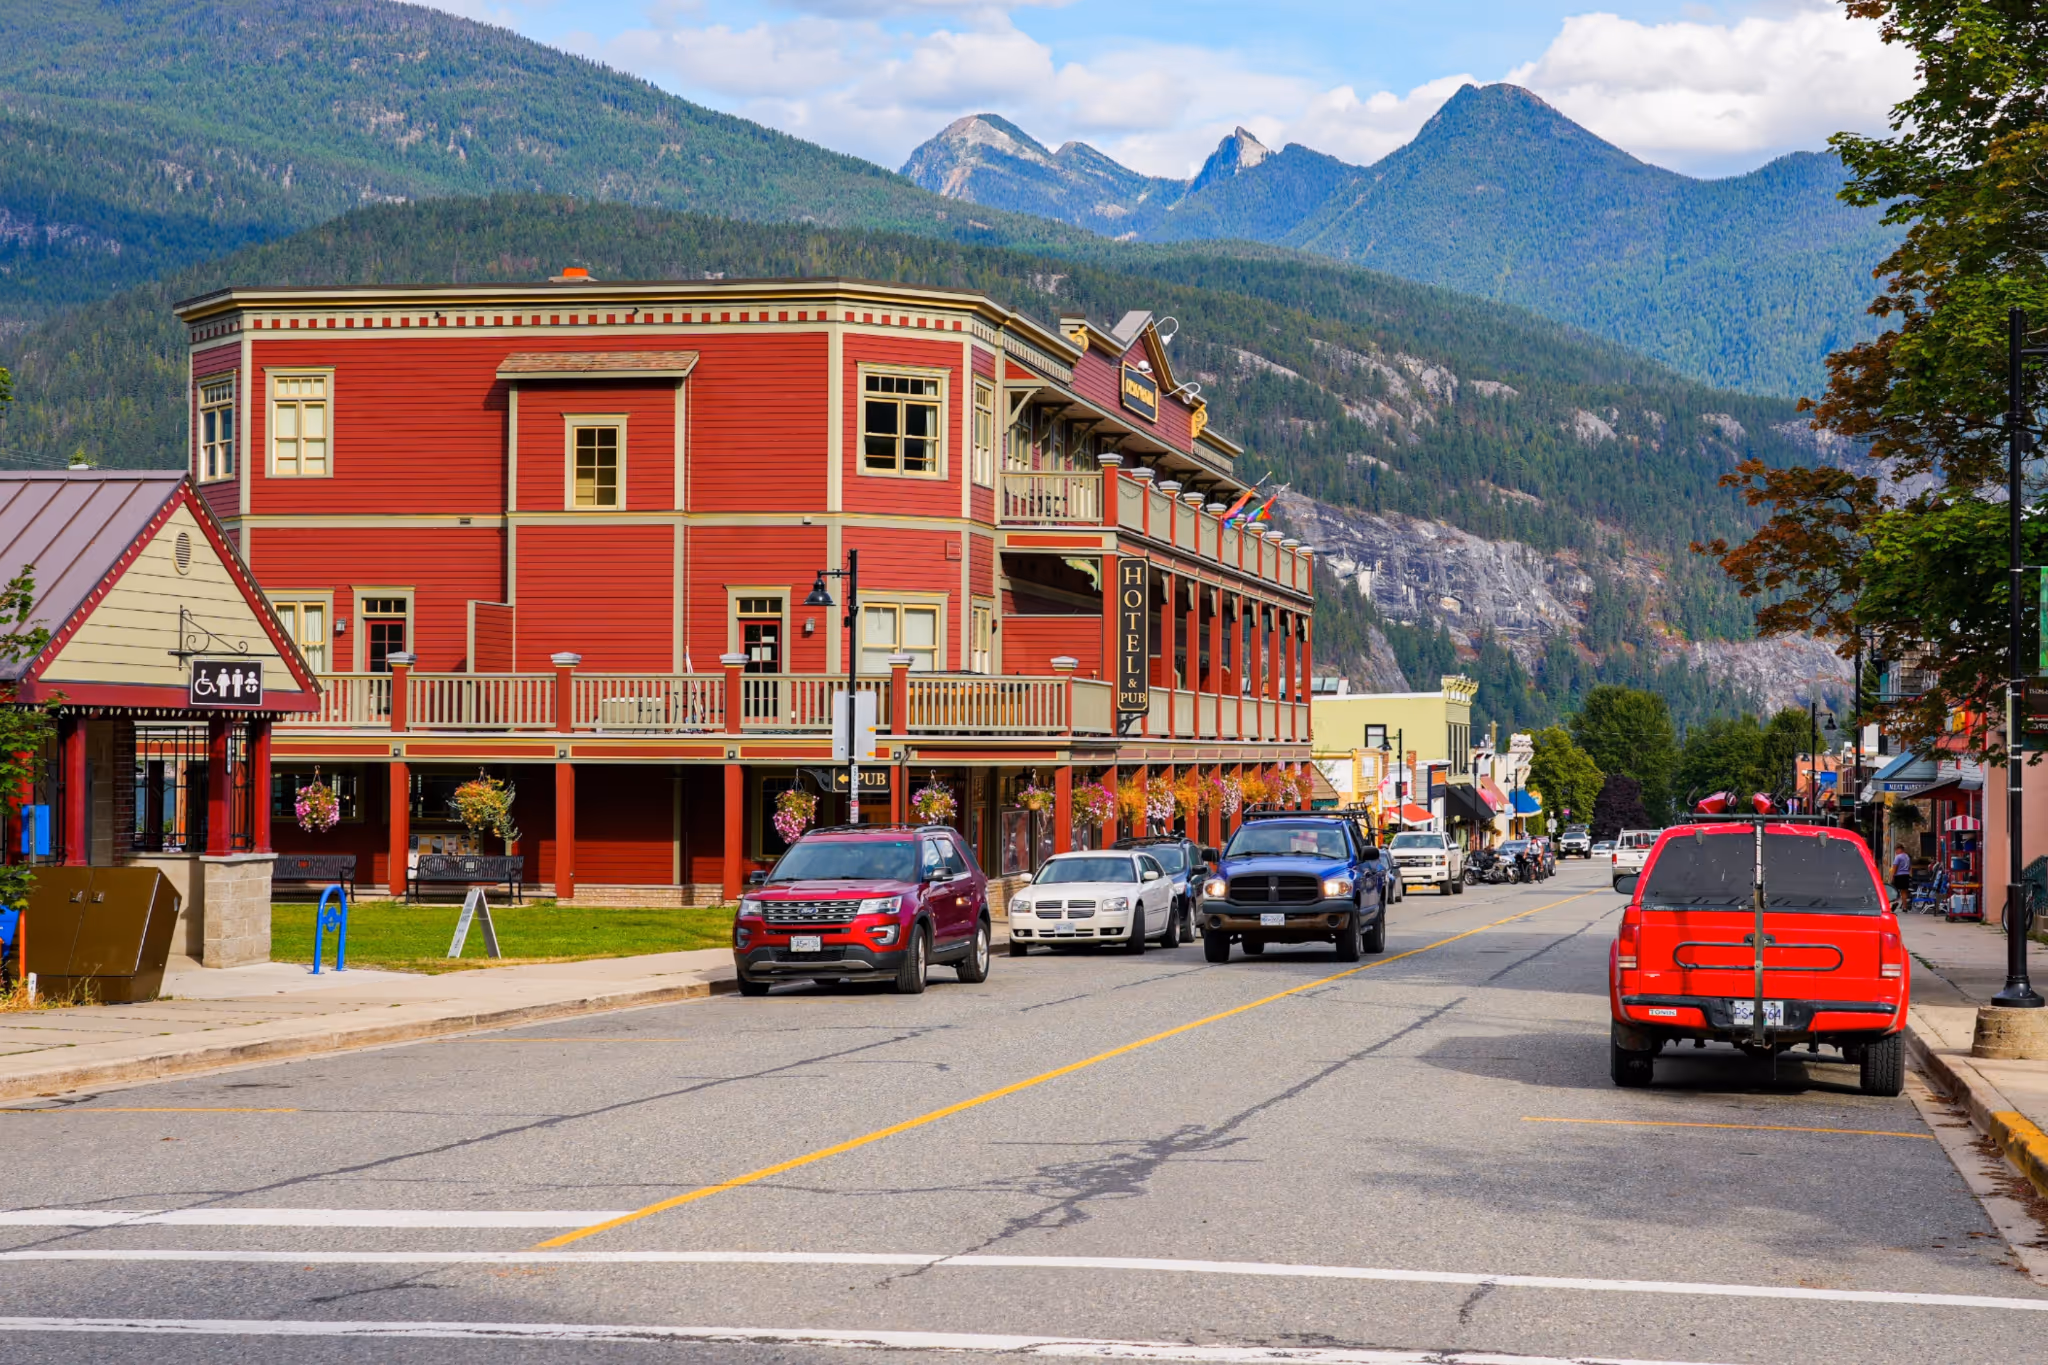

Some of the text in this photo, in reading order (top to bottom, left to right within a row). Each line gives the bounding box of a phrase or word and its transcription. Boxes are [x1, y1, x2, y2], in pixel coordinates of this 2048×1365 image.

[1123, 566, 1143, 674] HOTEL
[1127, 678, 1138, 689] &
[1120, 691, 1146, 703] PUB
[857, 772, 886, 786] PUB
